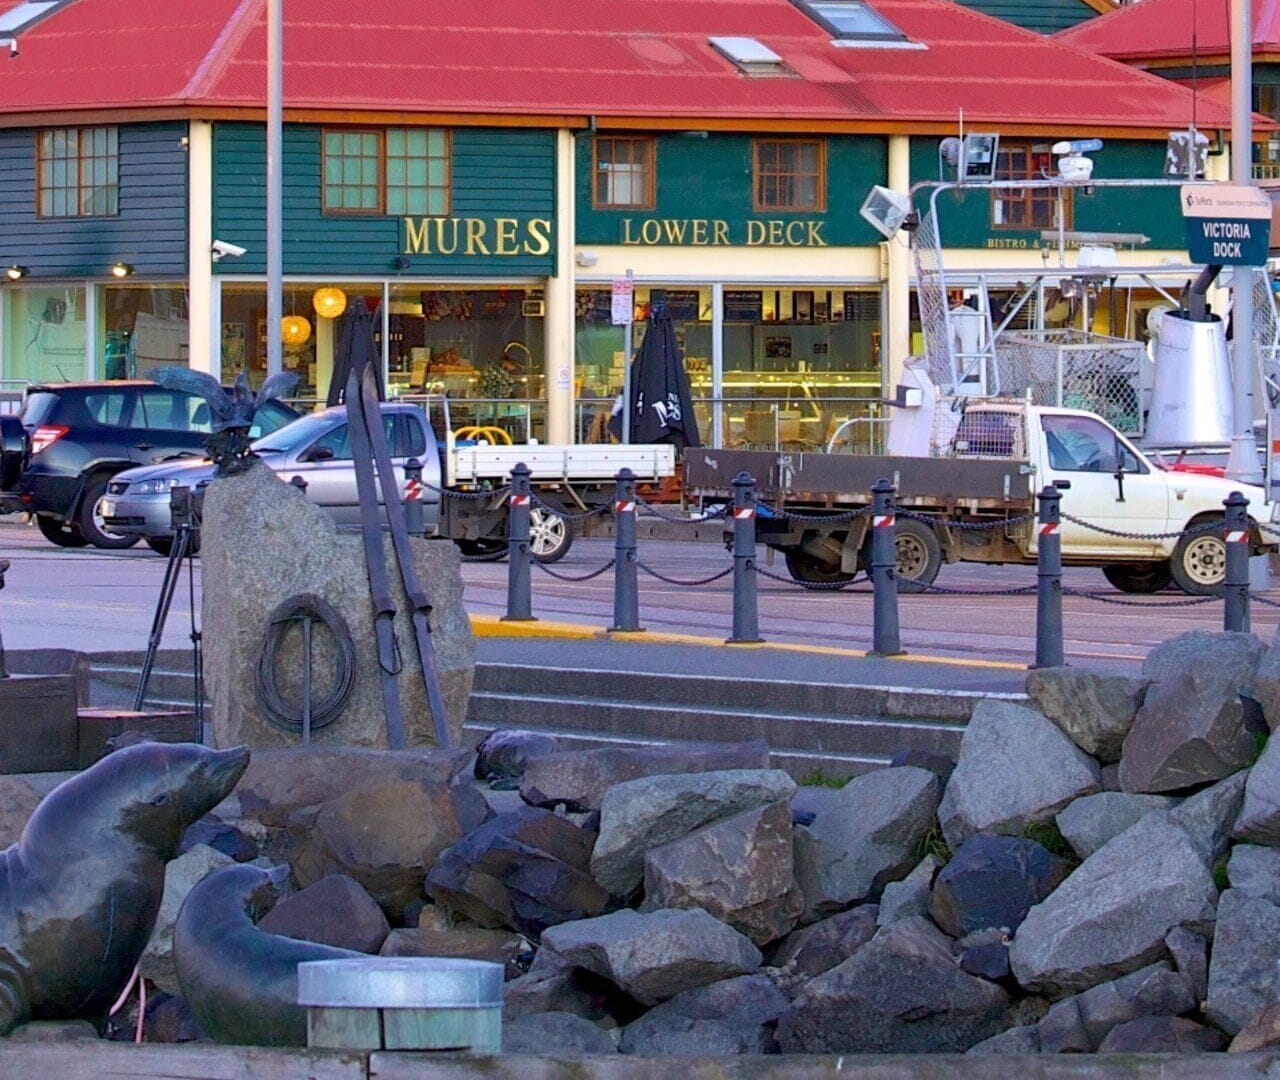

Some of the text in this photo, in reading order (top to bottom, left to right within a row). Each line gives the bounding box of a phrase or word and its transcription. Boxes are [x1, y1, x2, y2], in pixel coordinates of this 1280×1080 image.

[404, 218, 551, 257] MURES
[623, 219, 827, 247] LOWER DECK
[1203, 222, 1251, 239] VICTORIA
[988, 238, 1027, 249] BISTRO
[1213, 242, 1242, 258] DOCK
